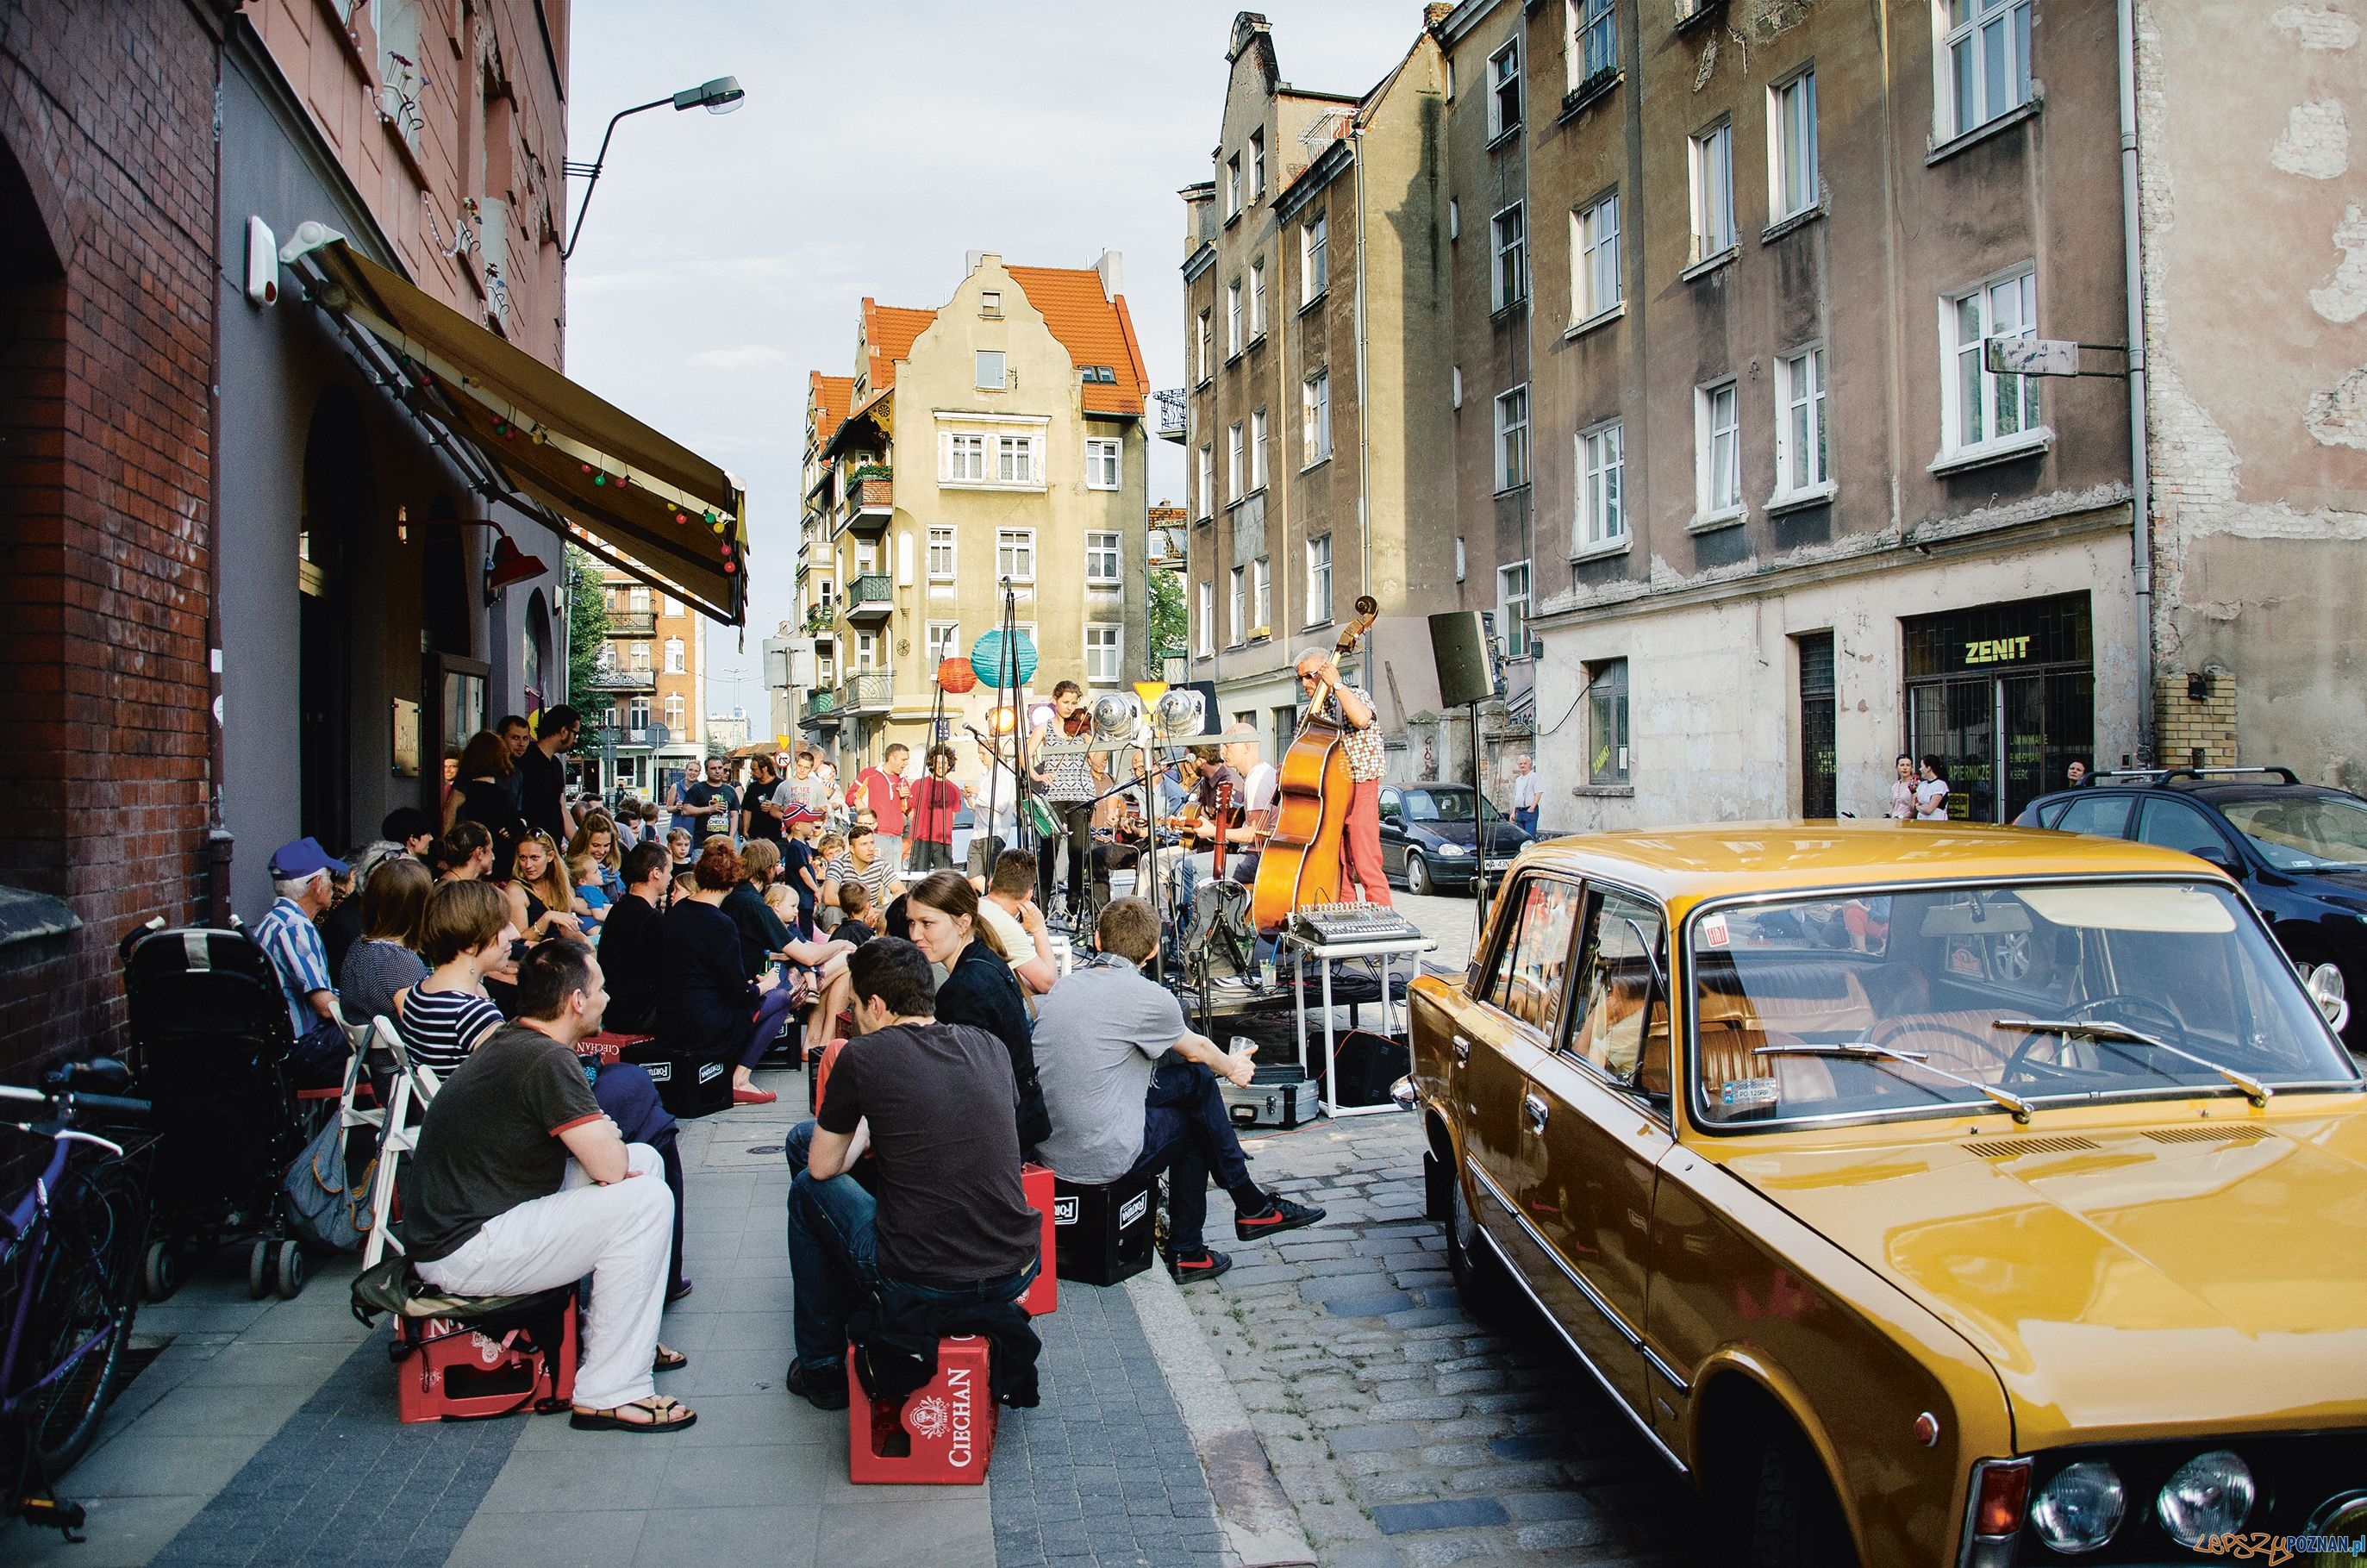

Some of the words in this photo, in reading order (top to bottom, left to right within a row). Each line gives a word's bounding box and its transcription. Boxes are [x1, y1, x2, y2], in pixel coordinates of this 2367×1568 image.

[1965, 636, 2030, 664] ZENIT
[1948, 765, 1989, 781] APIERNICZE
[1708, 926, 1727, 946] FIAT
[577, 1041, 620, 1056] CIECHAN
[948, 1367, 972, 1468] CIECHAN
